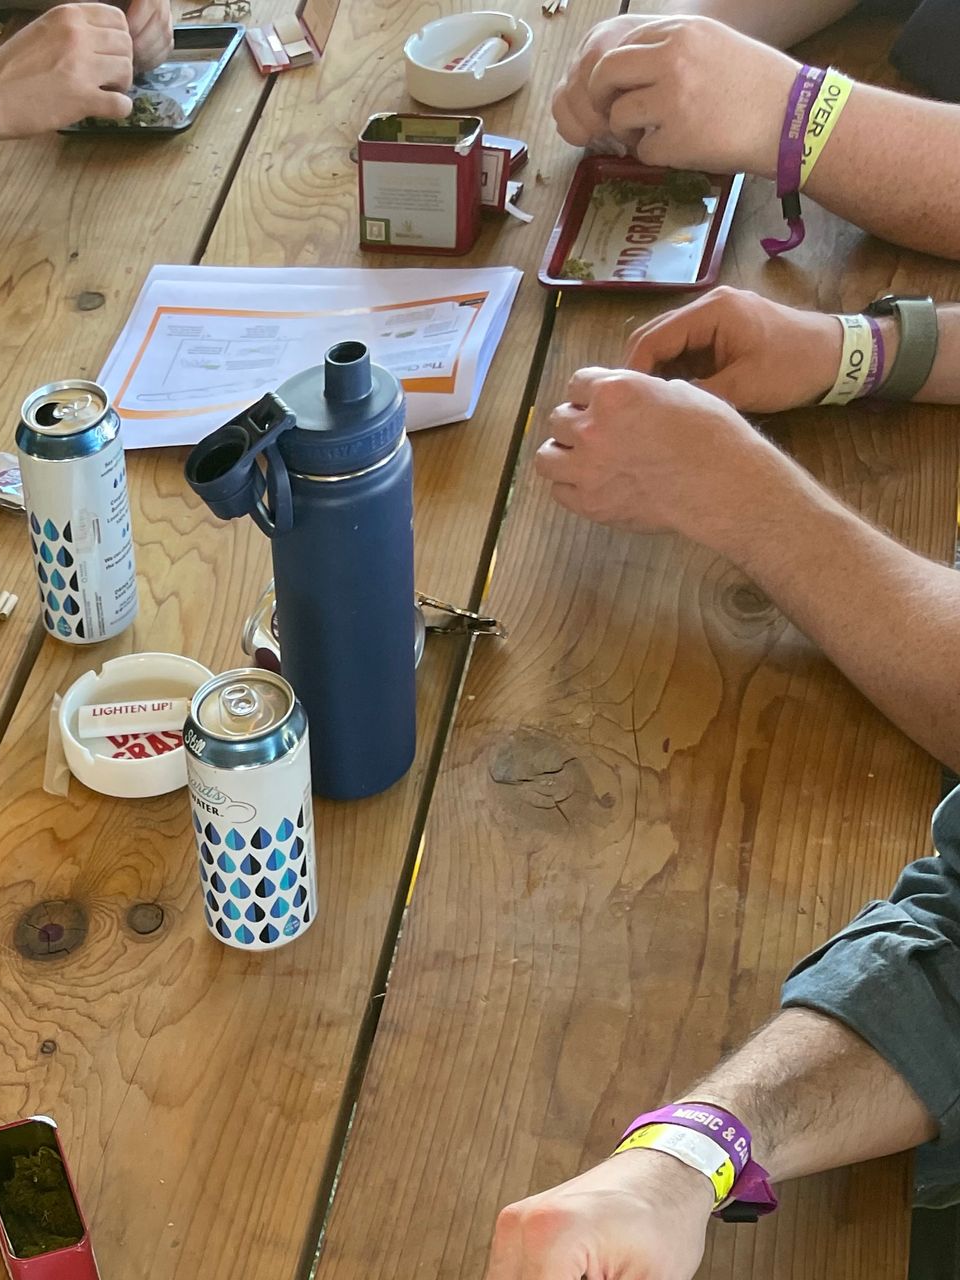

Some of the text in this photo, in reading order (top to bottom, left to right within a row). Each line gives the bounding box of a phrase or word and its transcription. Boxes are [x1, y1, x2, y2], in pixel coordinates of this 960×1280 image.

[789, 91, 812, 139] CAMPING
[807, 85, 839, 136] OVER
[613, 247, 653, 278] DAD
[92, 702, 172, 716] LIGHTEN UP!
[185, 729, 206, 756] Still
[672, 1109, 735, 1142] MUSIC &
